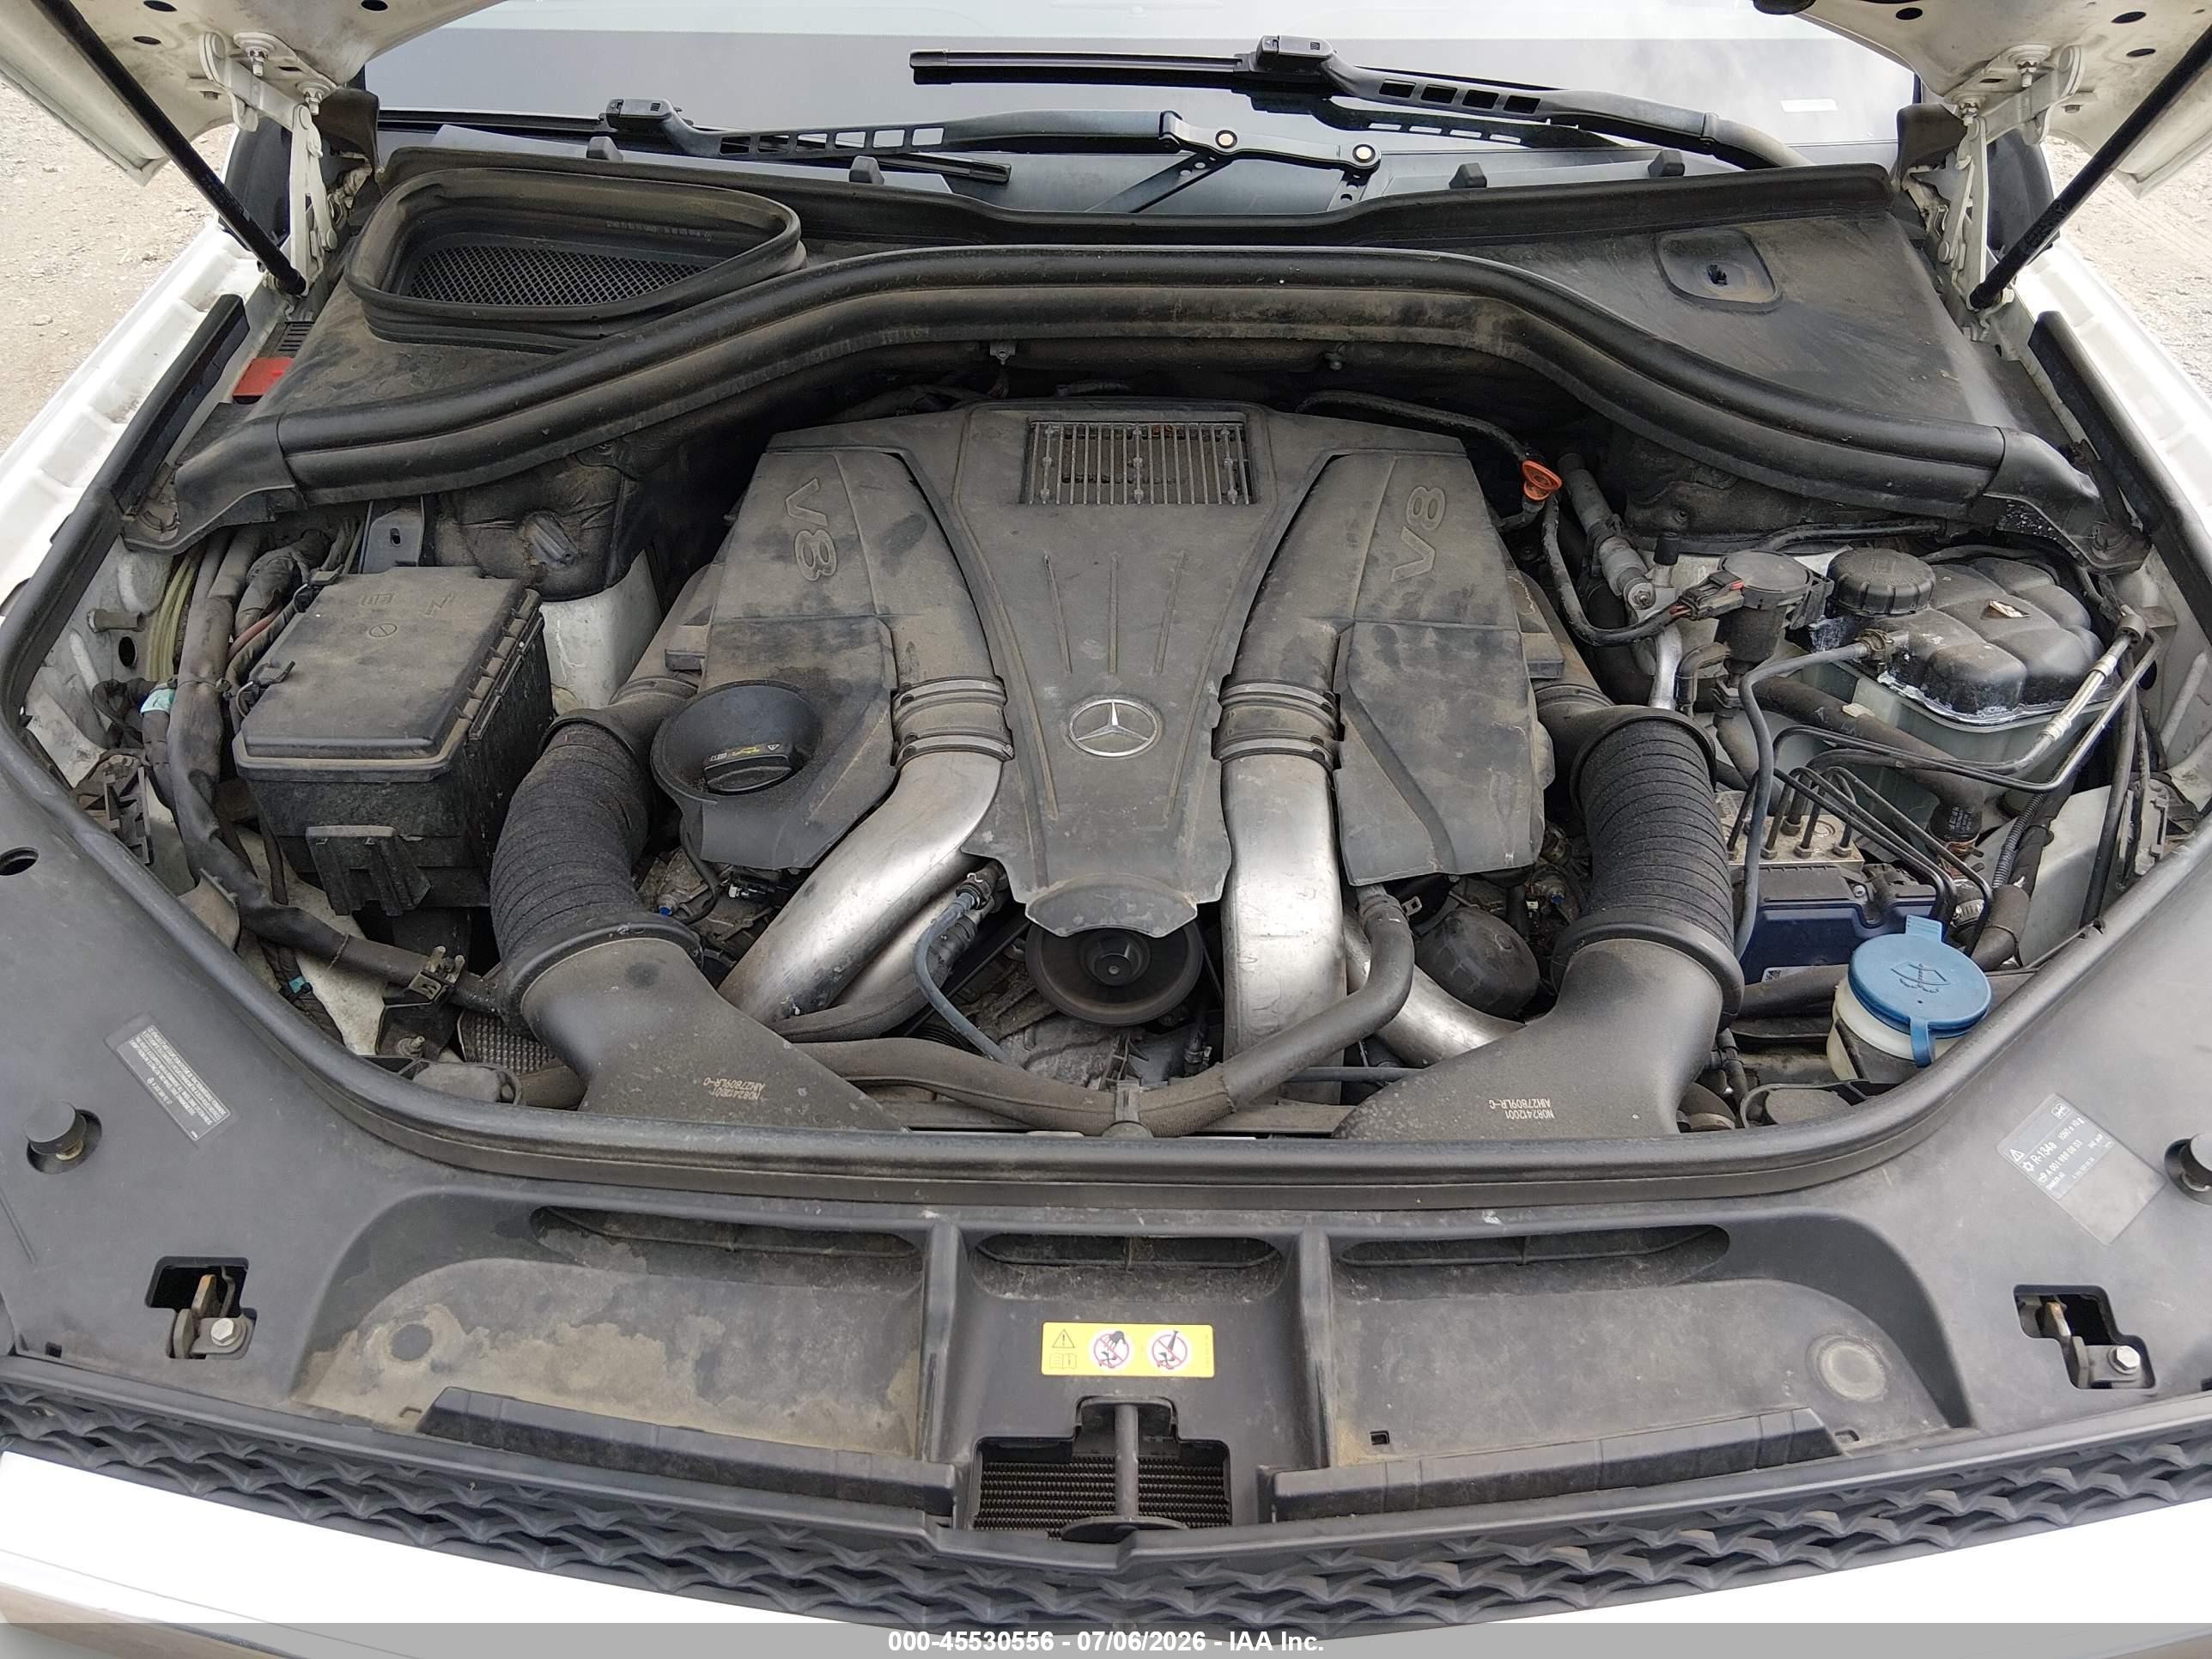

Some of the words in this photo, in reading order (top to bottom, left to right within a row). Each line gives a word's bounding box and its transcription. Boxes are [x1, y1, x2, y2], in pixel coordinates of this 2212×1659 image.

[785, 477, 838, 581] V8
[1390, 485, 1447, 583] V8
[2029, 1140, 2057, 1164] R-134a
